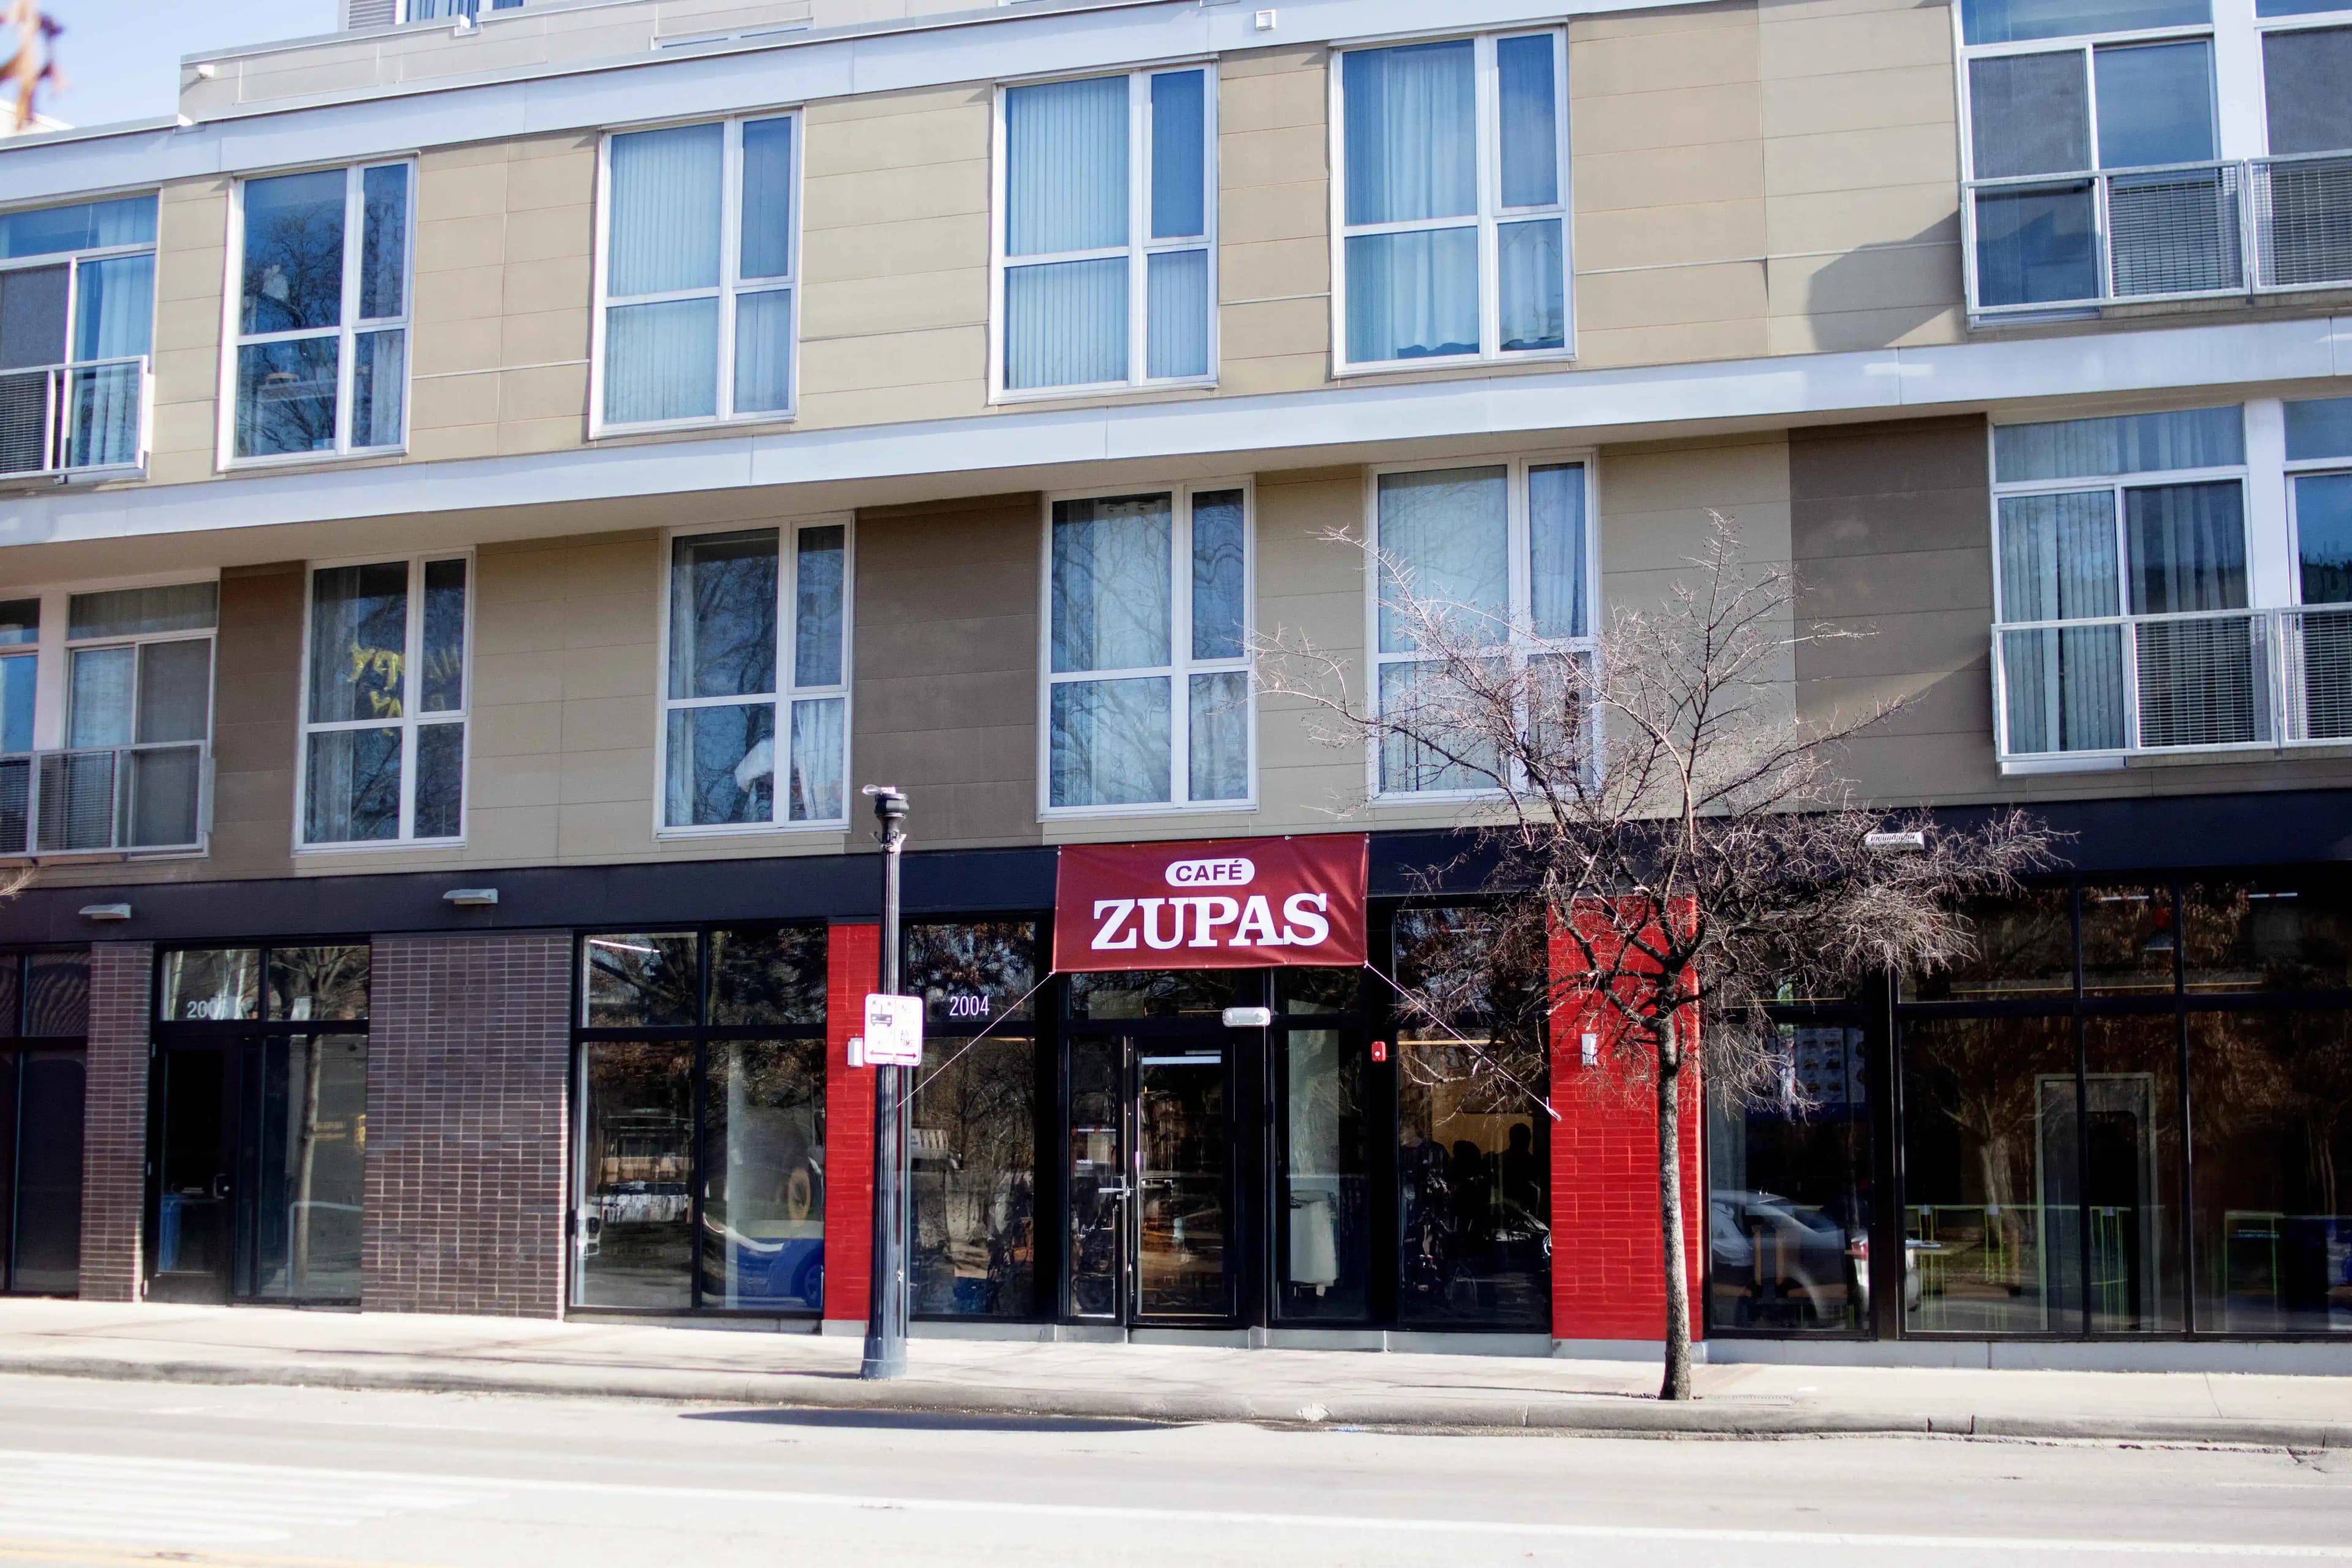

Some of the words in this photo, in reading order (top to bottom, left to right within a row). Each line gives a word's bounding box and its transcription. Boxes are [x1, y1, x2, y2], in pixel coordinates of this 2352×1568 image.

[1175, 859, 1243, 882] CAFÉ
[1091, 892, 1329, 951] ZUPAS
[949, 995, 990, 1016] 2004
